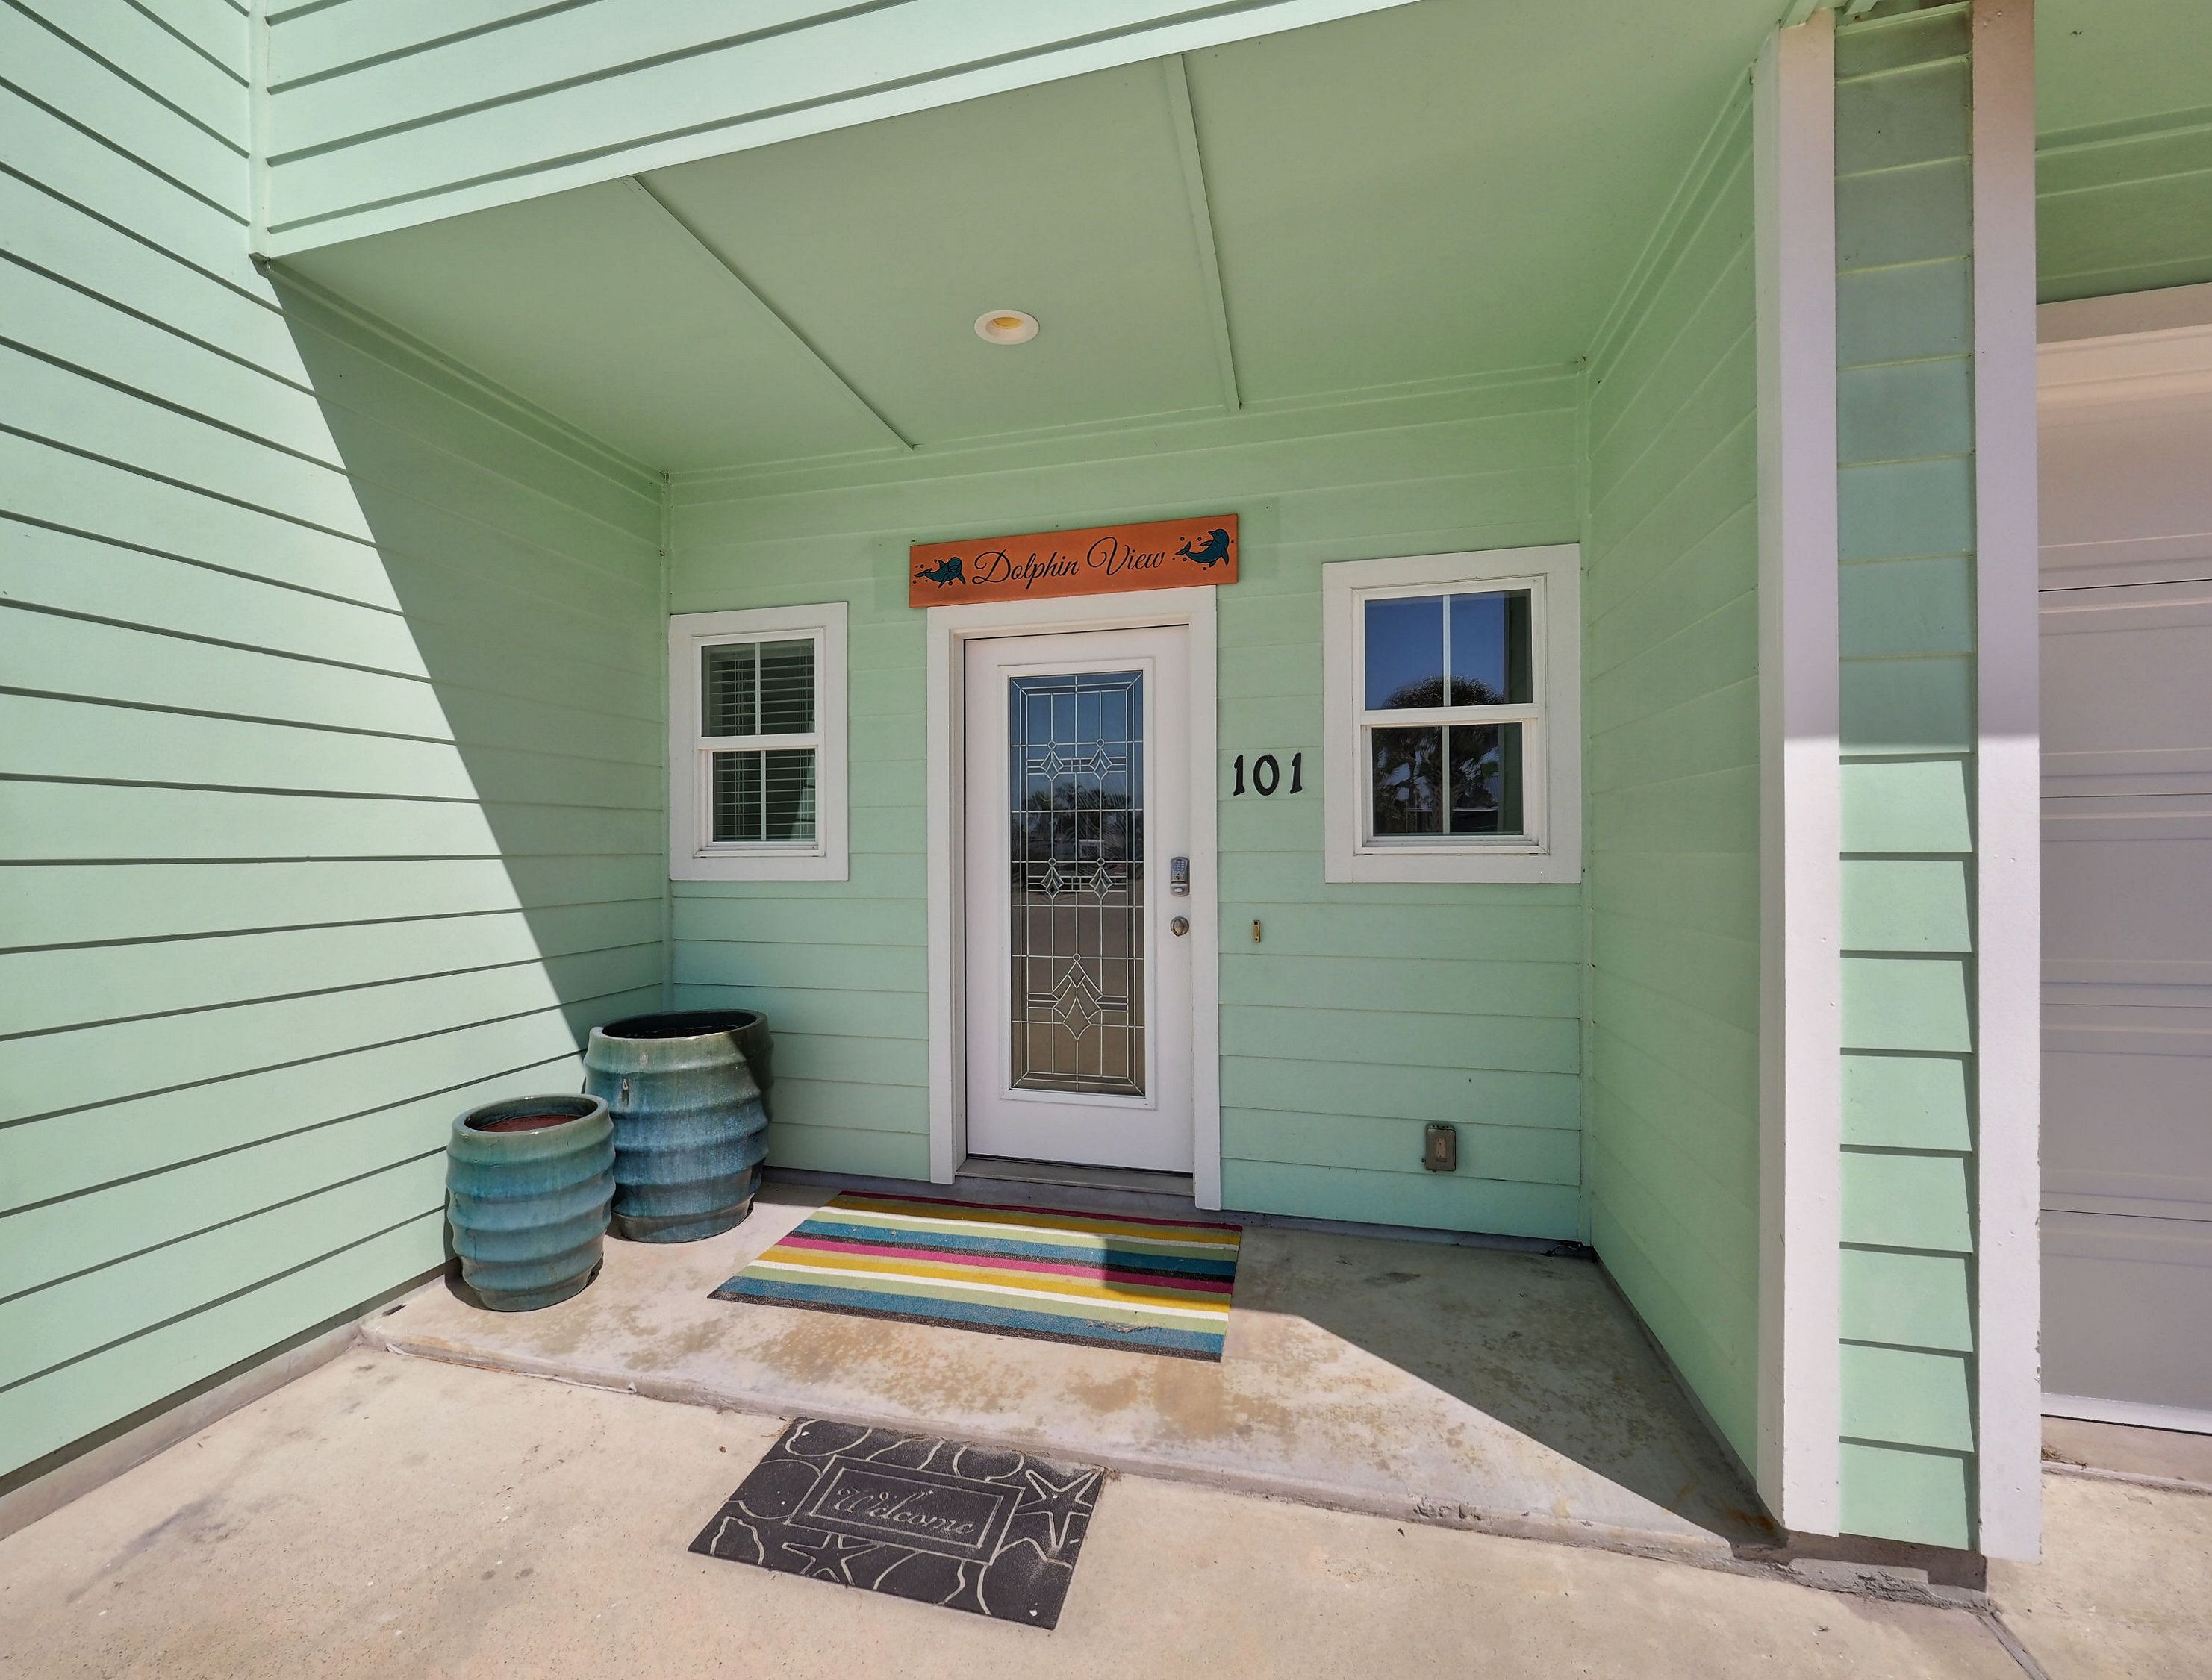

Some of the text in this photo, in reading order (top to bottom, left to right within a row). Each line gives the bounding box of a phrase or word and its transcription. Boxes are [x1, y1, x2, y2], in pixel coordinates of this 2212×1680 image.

[972, 536, 1165, 590] Dolphin View
[1233, 752, 1303, 796] 101
[834, 1486, 974, 1534] Welcome
